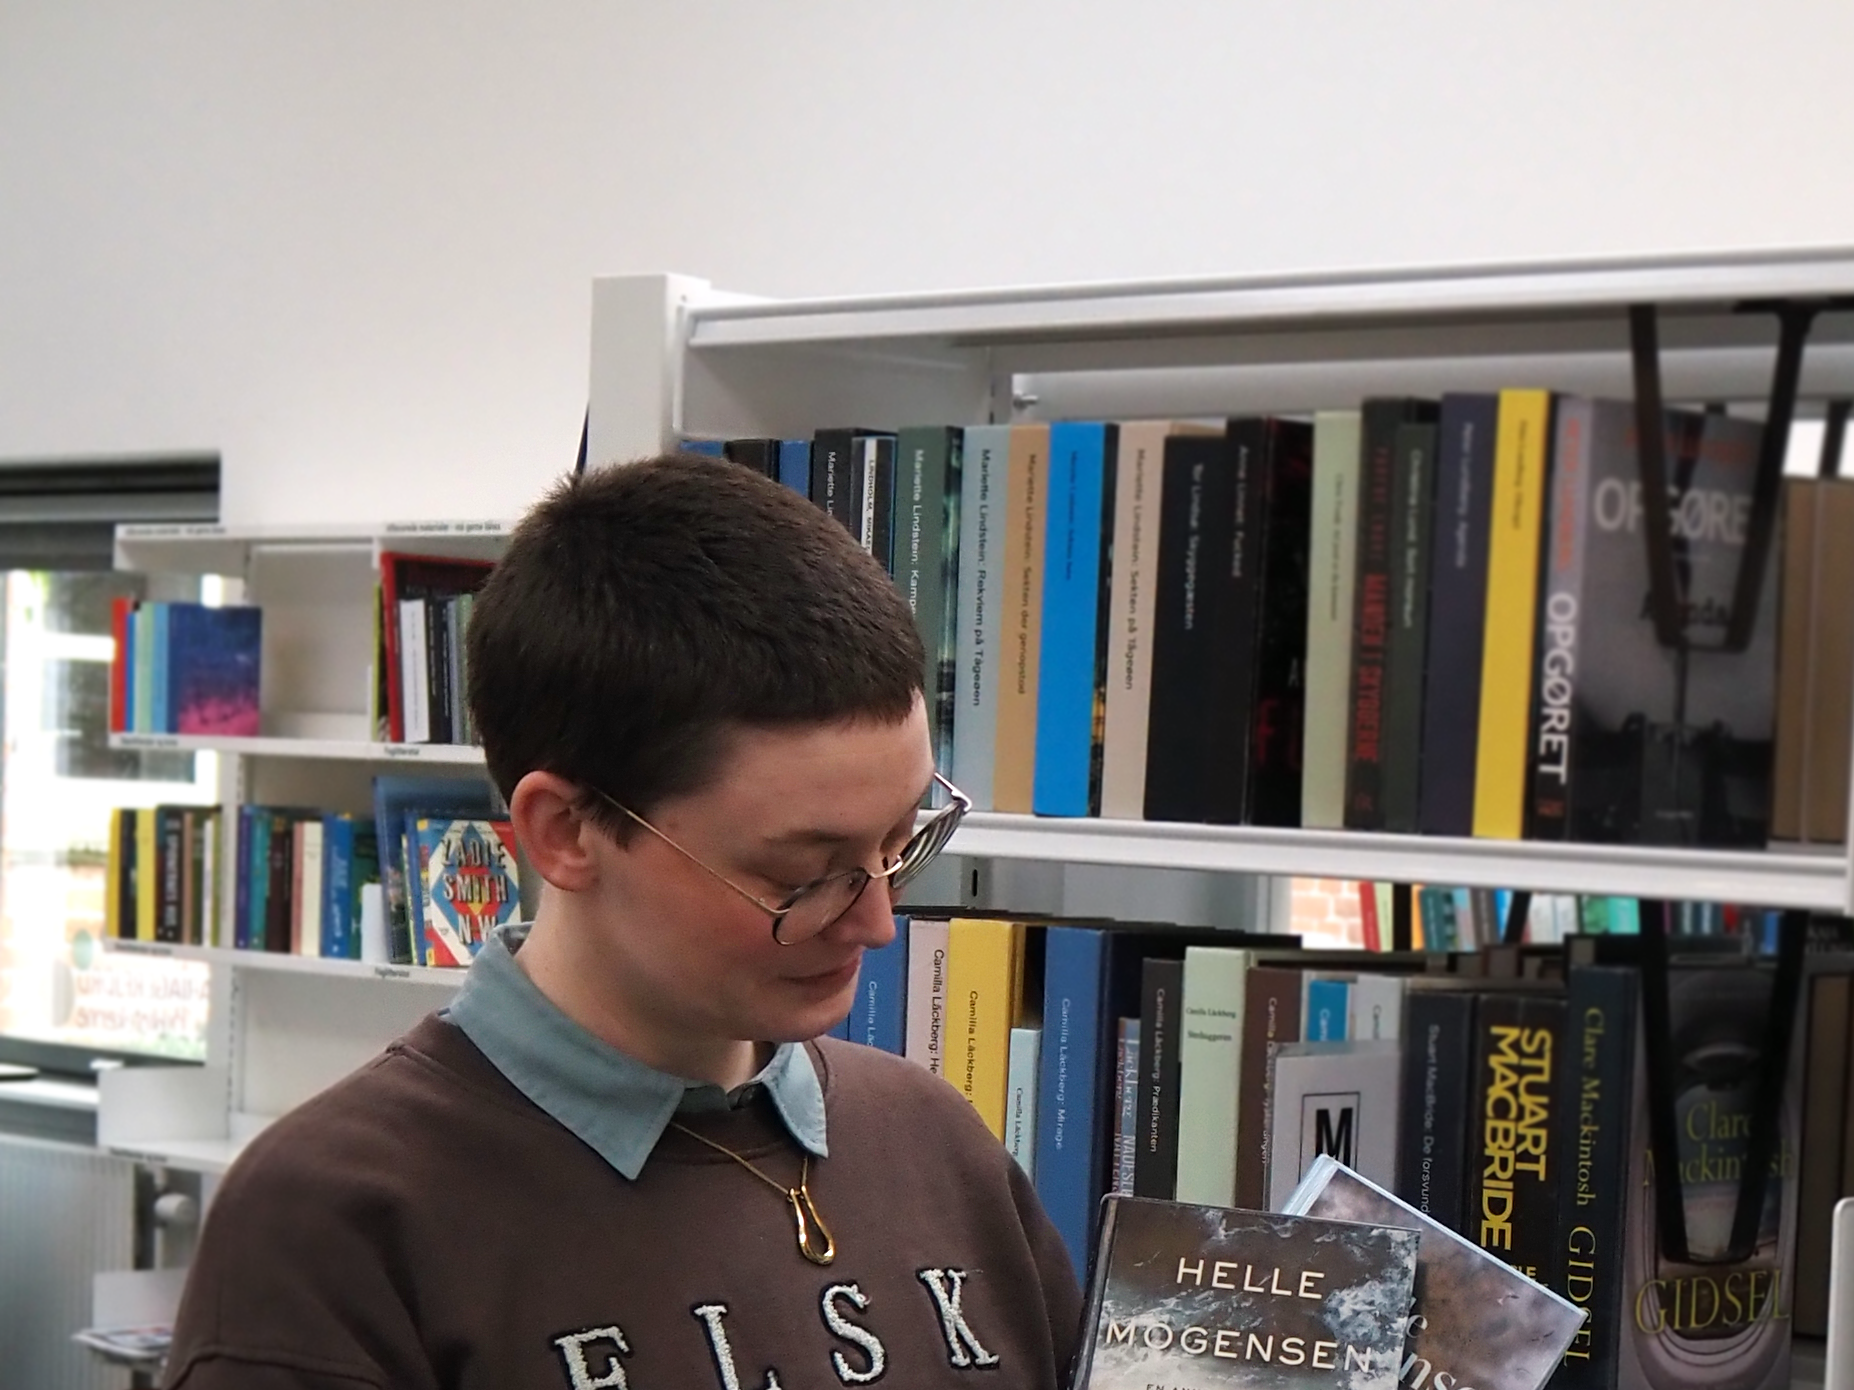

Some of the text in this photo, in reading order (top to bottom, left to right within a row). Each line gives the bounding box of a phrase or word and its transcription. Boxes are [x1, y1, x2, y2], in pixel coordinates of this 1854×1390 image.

[970, 448, 992, 707] Mariette Lindstein: Rekviem på Tågeøen
[1019, 453, 1037, 630] Mariette der
[1122, 449, 1147, 691] Mariette Lindstein: Sekten på Tågeøen
[1352, 572, 1388, 763] MANDEN SKYGGERNE
[1538, 592, 1578, 786] OPGØRET
[441, 838, 506, 869] ZADIE
[442, 873, 508, 903] SMITH
[927, 948, 946, 1055] Camilla Läckberg:
[963, 989, 979, 1096] Camilla Läckberg:
[1059, 997, 1072, 1043] Camilla
[1149, 987, 1166, 1152] Camilla Prædikanten
[1481, 1025, 1521, 1251] MACBRIDE
[1516, 1028, 1552, 1182] STUART
[1564, 1007, 1605, 1368] Clare Mackintosh GIDSEL
[1105, 1319, 1373, 1374] MOGENSEN
[1177, 1257, 1327, 1300] HELLE
[1635, 1269, 1791, 1336] GIDSEL
